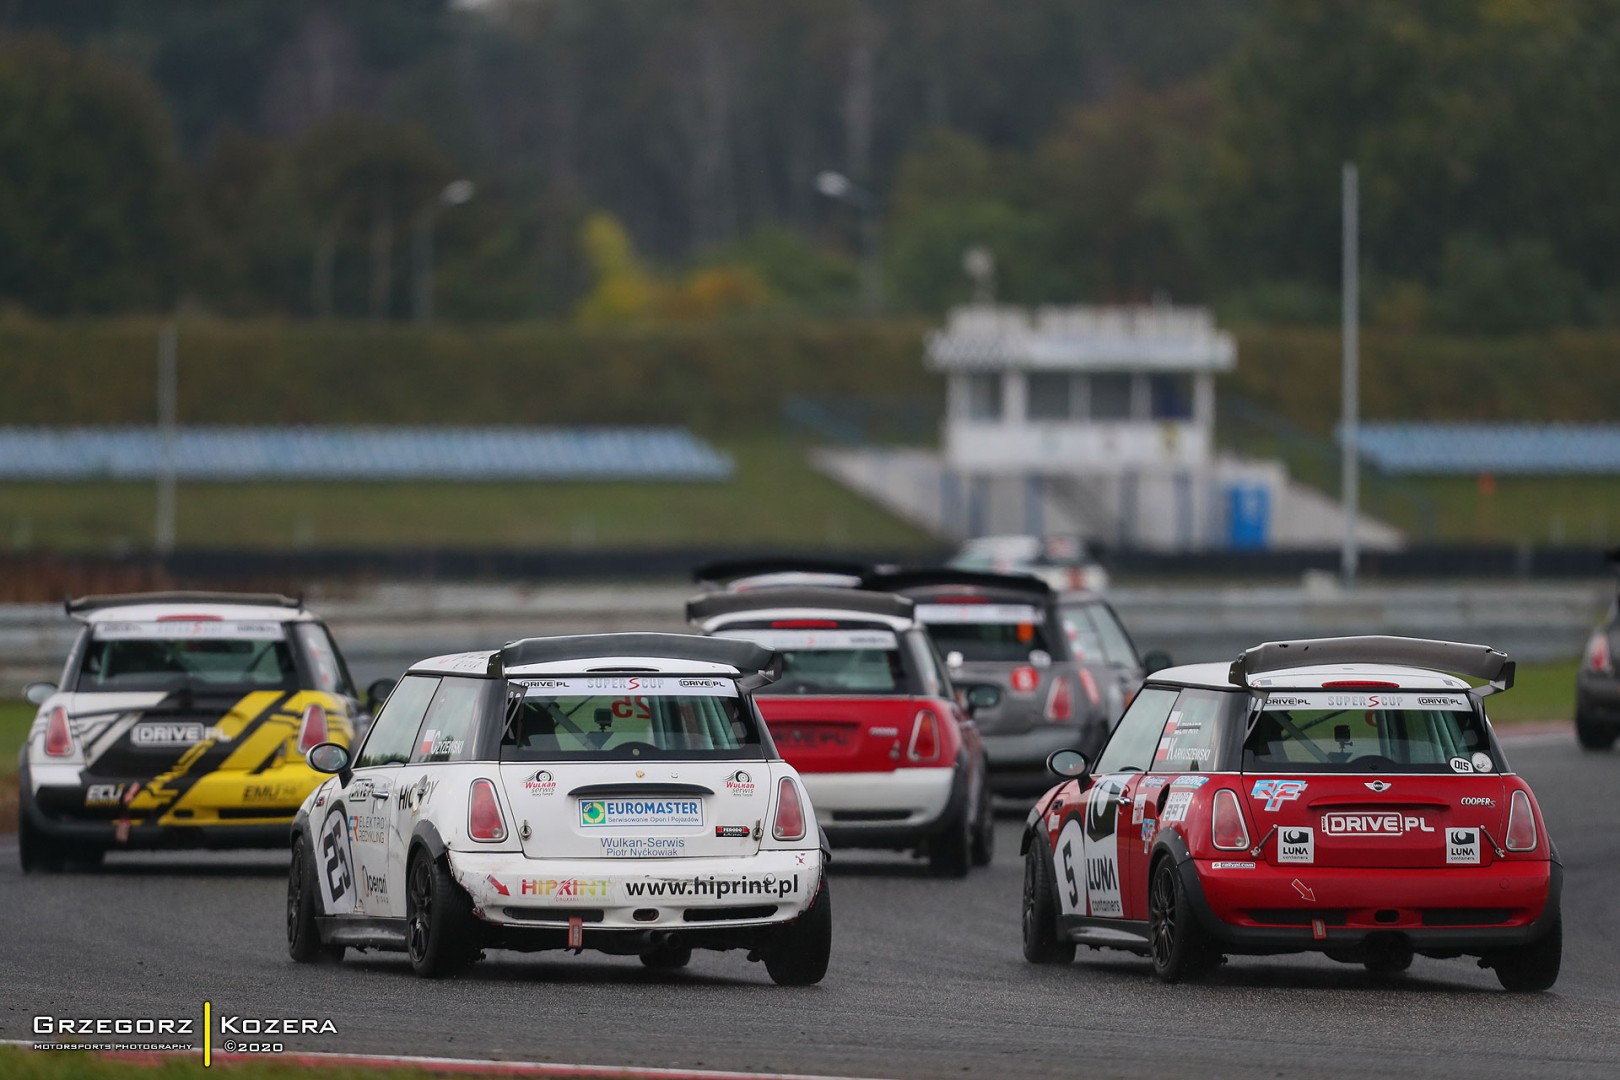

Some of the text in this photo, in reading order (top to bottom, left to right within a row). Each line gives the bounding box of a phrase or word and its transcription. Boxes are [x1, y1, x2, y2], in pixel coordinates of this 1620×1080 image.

[587, 677, 626, 688] SUPER
[642, 677, 664, 688] CUP
[1328, 695, 1366, 707] SUPER
[1381, 696, 1404, 707] CUP
[1460, 797, 1491, 806] COOPER
[607, 802, 698, 815] EUROMASTER
[600, 837, 685, 848] Wulkan-Serwis
[606, 848, 627, 857] Piotr
[1283, 846, 1309, 856] LUNA
[1451, 847, 1475, 857] LUNA
[323, 820, 352, 903] 25
[1062, 839, 1079, 908] 5
[1087, 855, 1118, 893] LUNA
[521, 874, 799, 899] HIPRINT www.hiprint.pl
